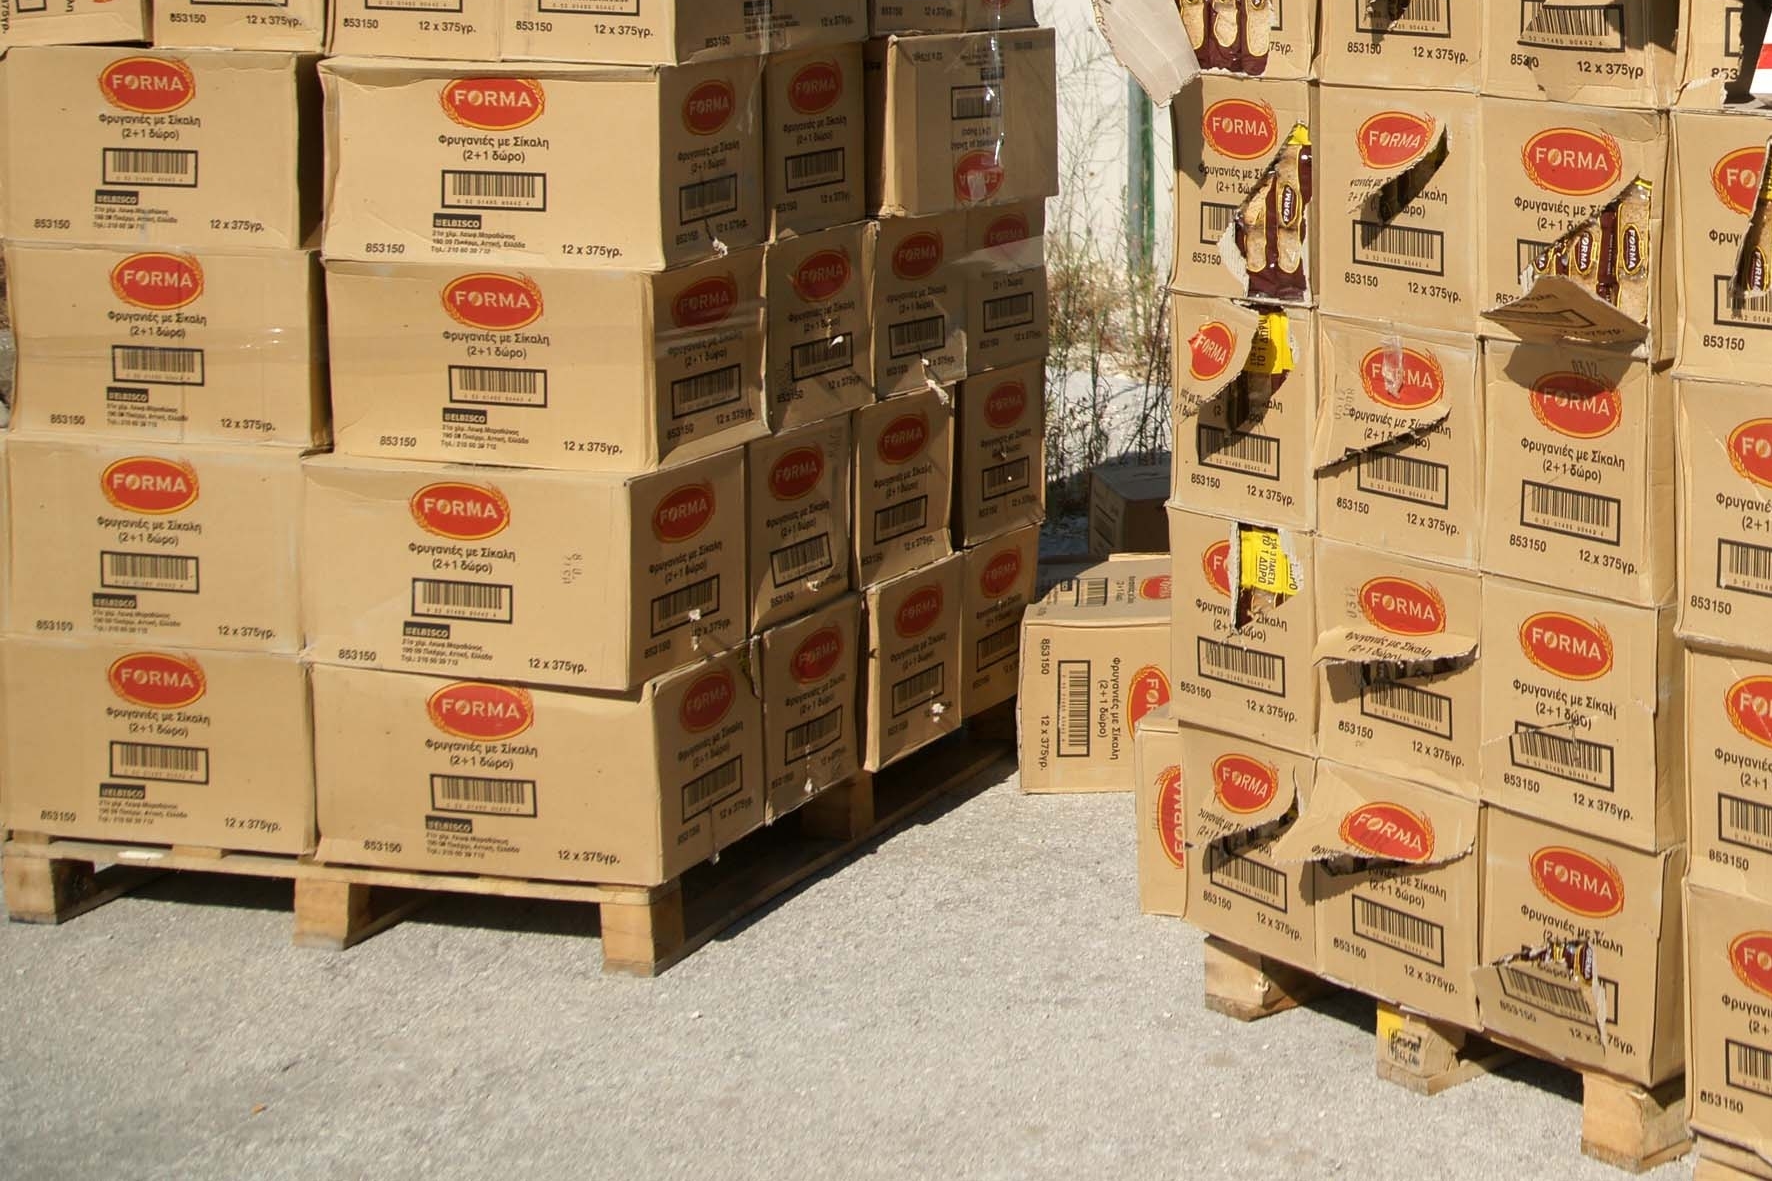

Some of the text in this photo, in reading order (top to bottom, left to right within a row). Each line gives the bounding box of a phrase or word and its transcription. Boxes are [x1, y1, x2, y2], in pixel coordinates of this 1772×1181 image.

[112, 74, 183, 92] FORMA
[454, 89, 532, 108] FORMA
[1212, 116, 1269, 138] FORMA
[1536, 148, 1608, 171] FORMA
[1282, 188, 1293, 221] FORMA
[34, 219, 71, 229] 853150
[366, 243, 405, 254] 853150
[562, 245, 573, 254] 12
[1626, 230, 1636, 268] FORMA
[1344, 273, 1378, 288] 853150
[455, 290, 531, 309] FORMA
[1520, 437, 1625, 471] Φρυγανιές με Σίκαλη
[424, 497, 497, 519] FORMA
[660, 502, 708, 528] FORMA
[1371, 593, 1435, 623] FORMA
[1690, 595, 1732, 615] 853150
[1532, 627, 1602, 660] FORMA
[1040, 639, 1050, 675] 853150
[121, 668, 194, 689] FORMA
[442, 699, 520, 719] FORMA
[1109, 658, 1120, 760] Φρυγανιές με Σίκαλη
[1221, 767, 1268, 800] FORMA
[1503, 773, 1540, 794] 853150
[1709, 849, 1749, 871] 853150
[1543, 860, 1612, 900] FORMA
